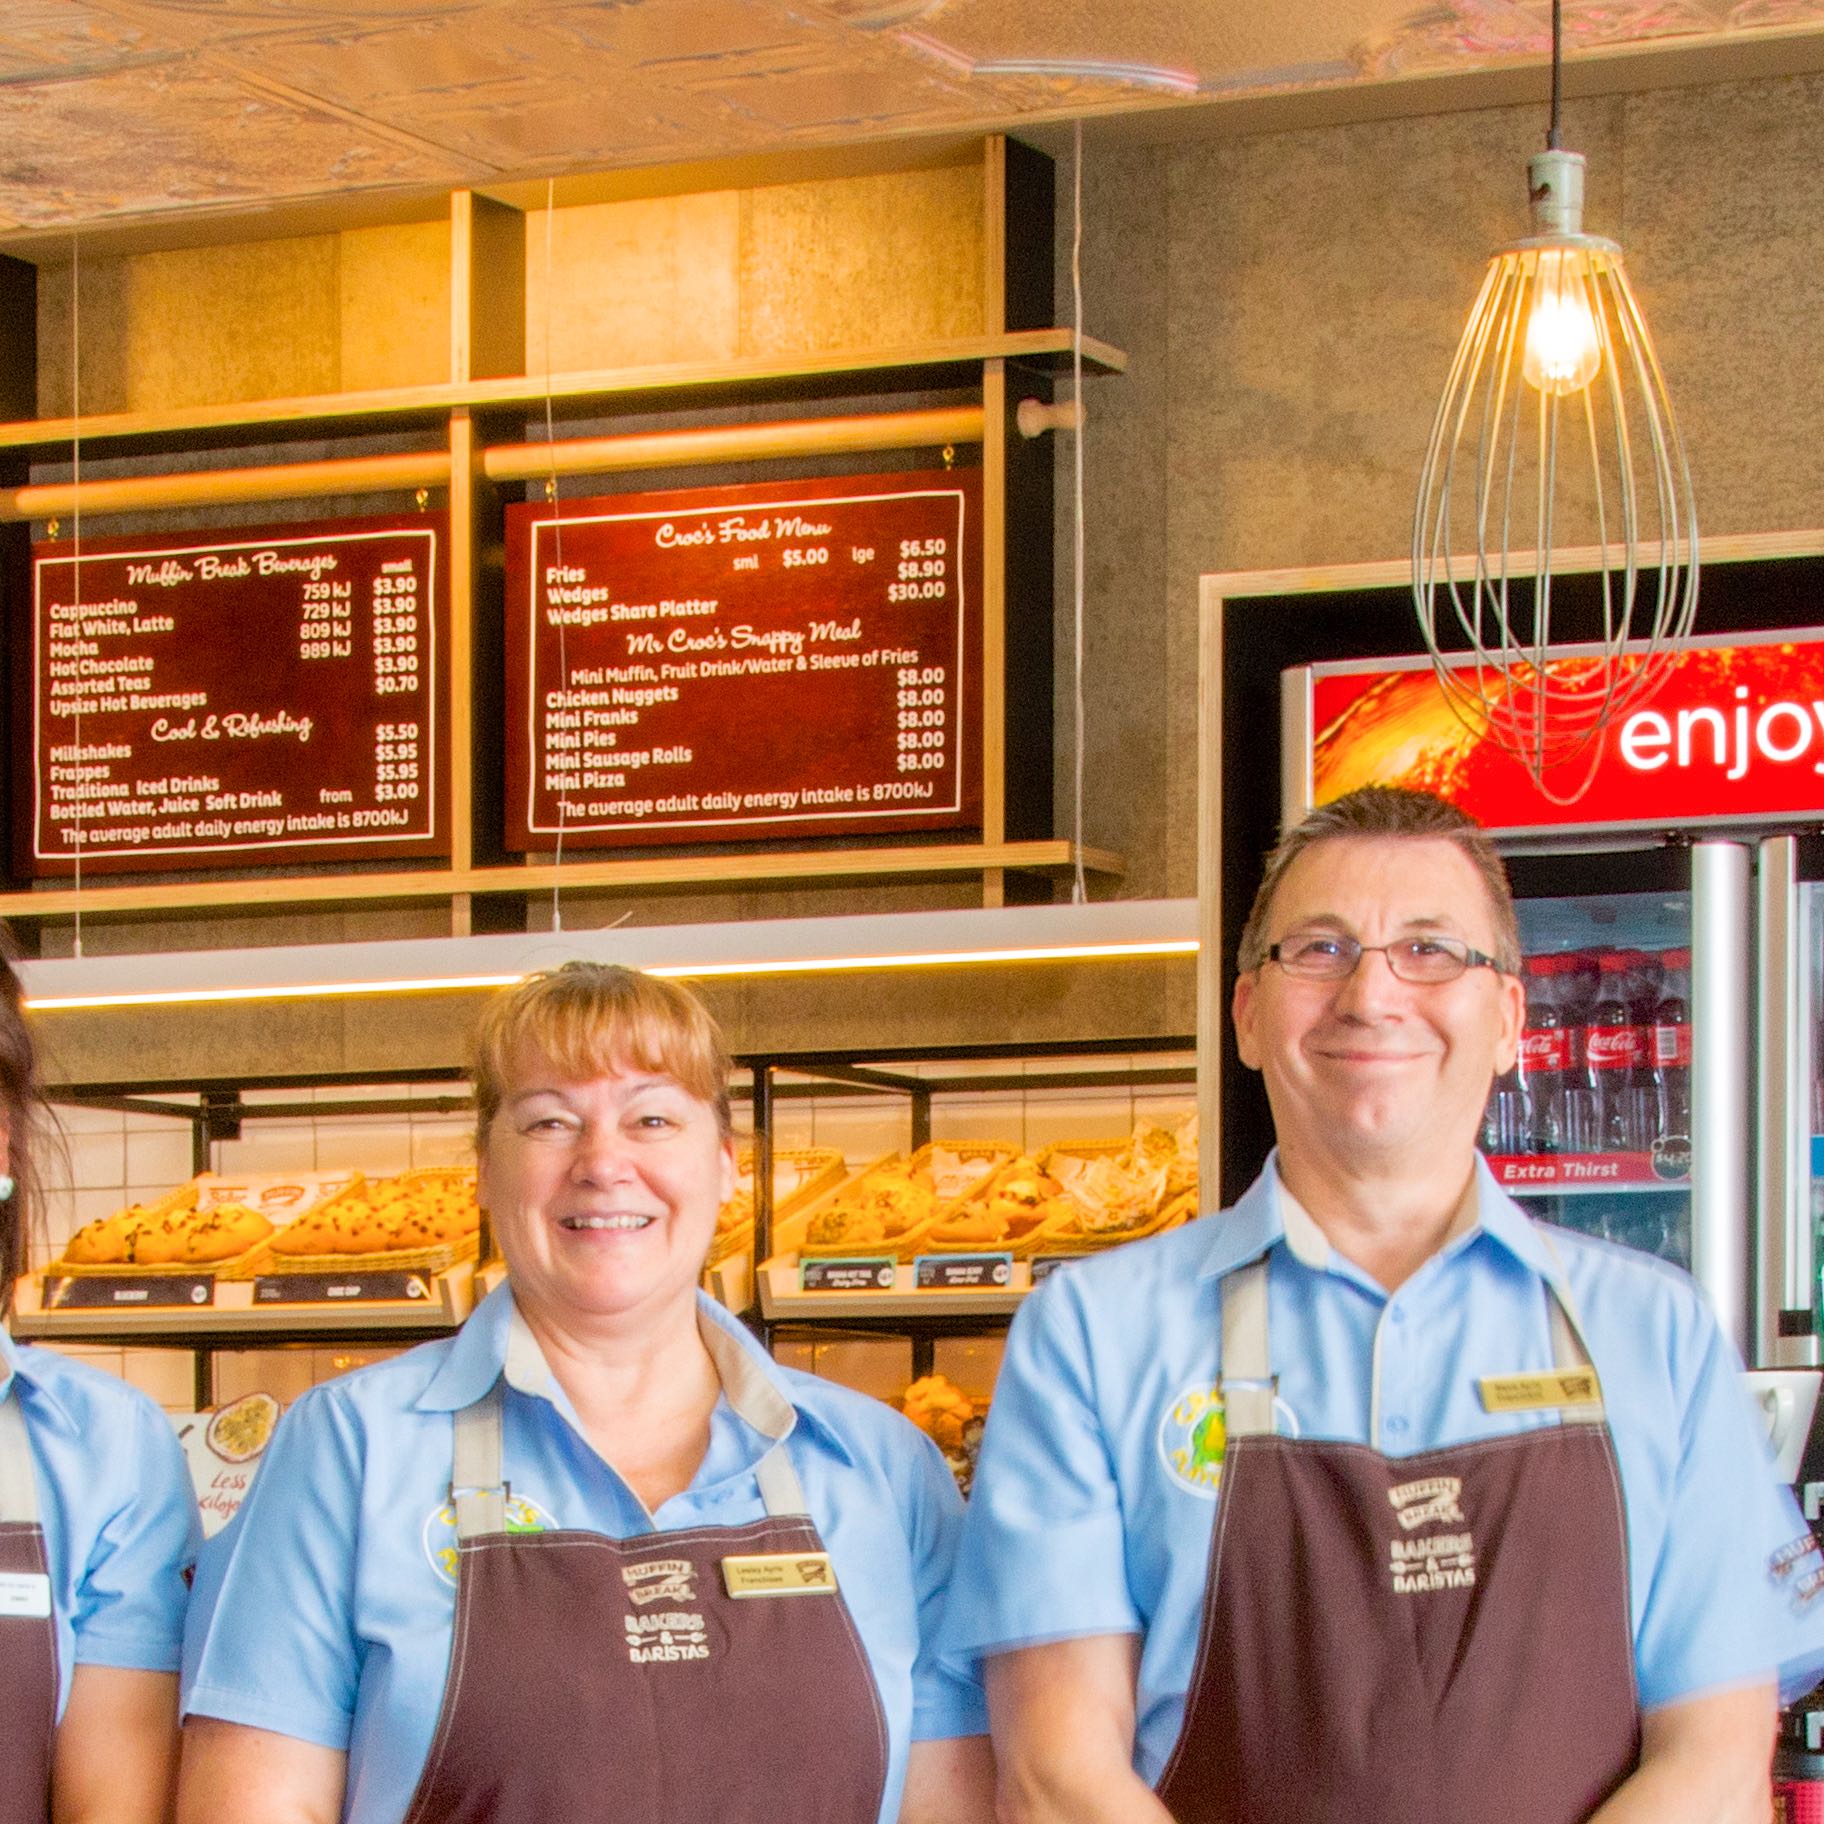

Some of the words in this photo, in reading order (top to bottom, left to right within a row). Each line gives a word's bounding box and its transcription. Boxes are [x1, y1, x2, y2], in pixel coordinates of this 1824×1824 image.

[720, 517, 770, 543] Food
[777, 517, 831, 538] Menu
[195, 556, 250, 579] Break
[546, 566, 585, 584] Fries
[783, 547, 829, 568] $5.00
[900, 538, 946, 559] $6.50
[50, 599, 137, 620] Cappuccino
[303, 583, 331, 599] 759
[374, 577, 416, 595] $3.90
[546, 587, 608, 606] Wedges
[898, 560, 945, 580] $8.90
[50, 622, 80, 638] Flat
[83, 619, 131, 636] White,
[133, 616, 174, 633] Latte
[302, 603, 330, 619] 729
[373, 597, 416, 615] $3.90
[547, 608, 608, 626] Wedges
[611, 603, 657, 619] Share
[660, 598, 718, 617] Platter
[888, 581, 945, 602] $30.00
[50, 641, 99, 658] Mocha
[374, 617, 416, 634] $3.90
[809, 618, 861, 641] Meal
[50, 661, 78, 677] Hot
[80, 656, 154, 675] Chocolate
[374, 637, 416, 655] $3.90
[571, 669, 603, 685] Mini
[606, 665, 658, 683] Muffin,
[661, 663, 698, 679] Fruit
[796, 655, 806, 671] &
[810, 653, 859, 670] Sleeve
[862, 650, 879, 666] of
[881, 648, 918, 665] Fries
[51, 677, 114, 696] Assorted
[117, 676, 151, 690] Teas
[375, 656, 418, 674] $3.90
[546, 690, 609, 708] Chicken
[612, 686, 679, 706] Nuggets
[897, 667, 944, 687] $8.00
[50, 699, 97, 718] Upsize
[101, 696, 128, 712] Hot
[130, 692, 207, 710] Beverages
[376, 675, 418, 695] $0.70
[546, 712, 581, 729] Mini
[584, 708, 638, 726] Franks
[897, 689, 944, 708] $8.00
[50, 743, 131, 762] Milkshakes
[376, 723, 417, 741] $5.50
[151, 718, 196, 742] Cool
[546, 732, 581, 749] Mini
[584, 730, 616, 747] Pies
[897, 709, 944, 729] $8.00
[50, 765, 110, 782] Frappes
[376, 743, 417, 761] $5.95
[546, 752, 581, 770] Mini
[583, 750, 649, 769] Sausage
[653, 746, 692, 763] Rolls
[897, 732, 944, 750] $8.00
[136, 779, 167, 795] Iced
[170, 775, 219, 793] Drinks
[376, 763, 418, 782] $5.95
[545, 773, 580, 790] Mini
[584, 771, 625, 788] Pizza
[897, 754, 944, 772] $8.00
[50, 802, 105, 820] Bottled
[107, 800, 157, 816] Water,
[205, 793, 238, 811] Soft
[240, 790, 282, 808] Drink
[320, 789, 352, 803] from
[375, 783, 418, 802] $3.00
[558, 801, 585, 818] The
[589, 798, 652, 817] average
[656, 795, 699, 812] adult
[702, 792, 741, 812] daily
[744, 792, 797, 809] energy
[802, 786, 853, 805] intake
[856, 785, 869, 801] is
[873, 782, 932, 800] 8700kJ
[62, 828, 87, 843] The
[90, 827, 149, 843] average
[152, 822, 192, 838] adult
[194, 819, 231, 838] daily
[234, 820, 284, 836] energy
[287, 814, 335, 830] intake
[337, 812, 350, 827] is
[352, 809, 408, 827] 8700kJ
[1504, 1165, 1555, 1179] Extra
[1564, 1163, 1618, 1177] Thirst
[627, 1562, 683, 1576] MUFFIN
[1393, 1568, 1475, 1593] BARISTAS
[625, 1613, 704, 1633] BAKERS
[660, 1631, 673, 1644] &
[629, 1645, 710, 1663] BARISTAS
